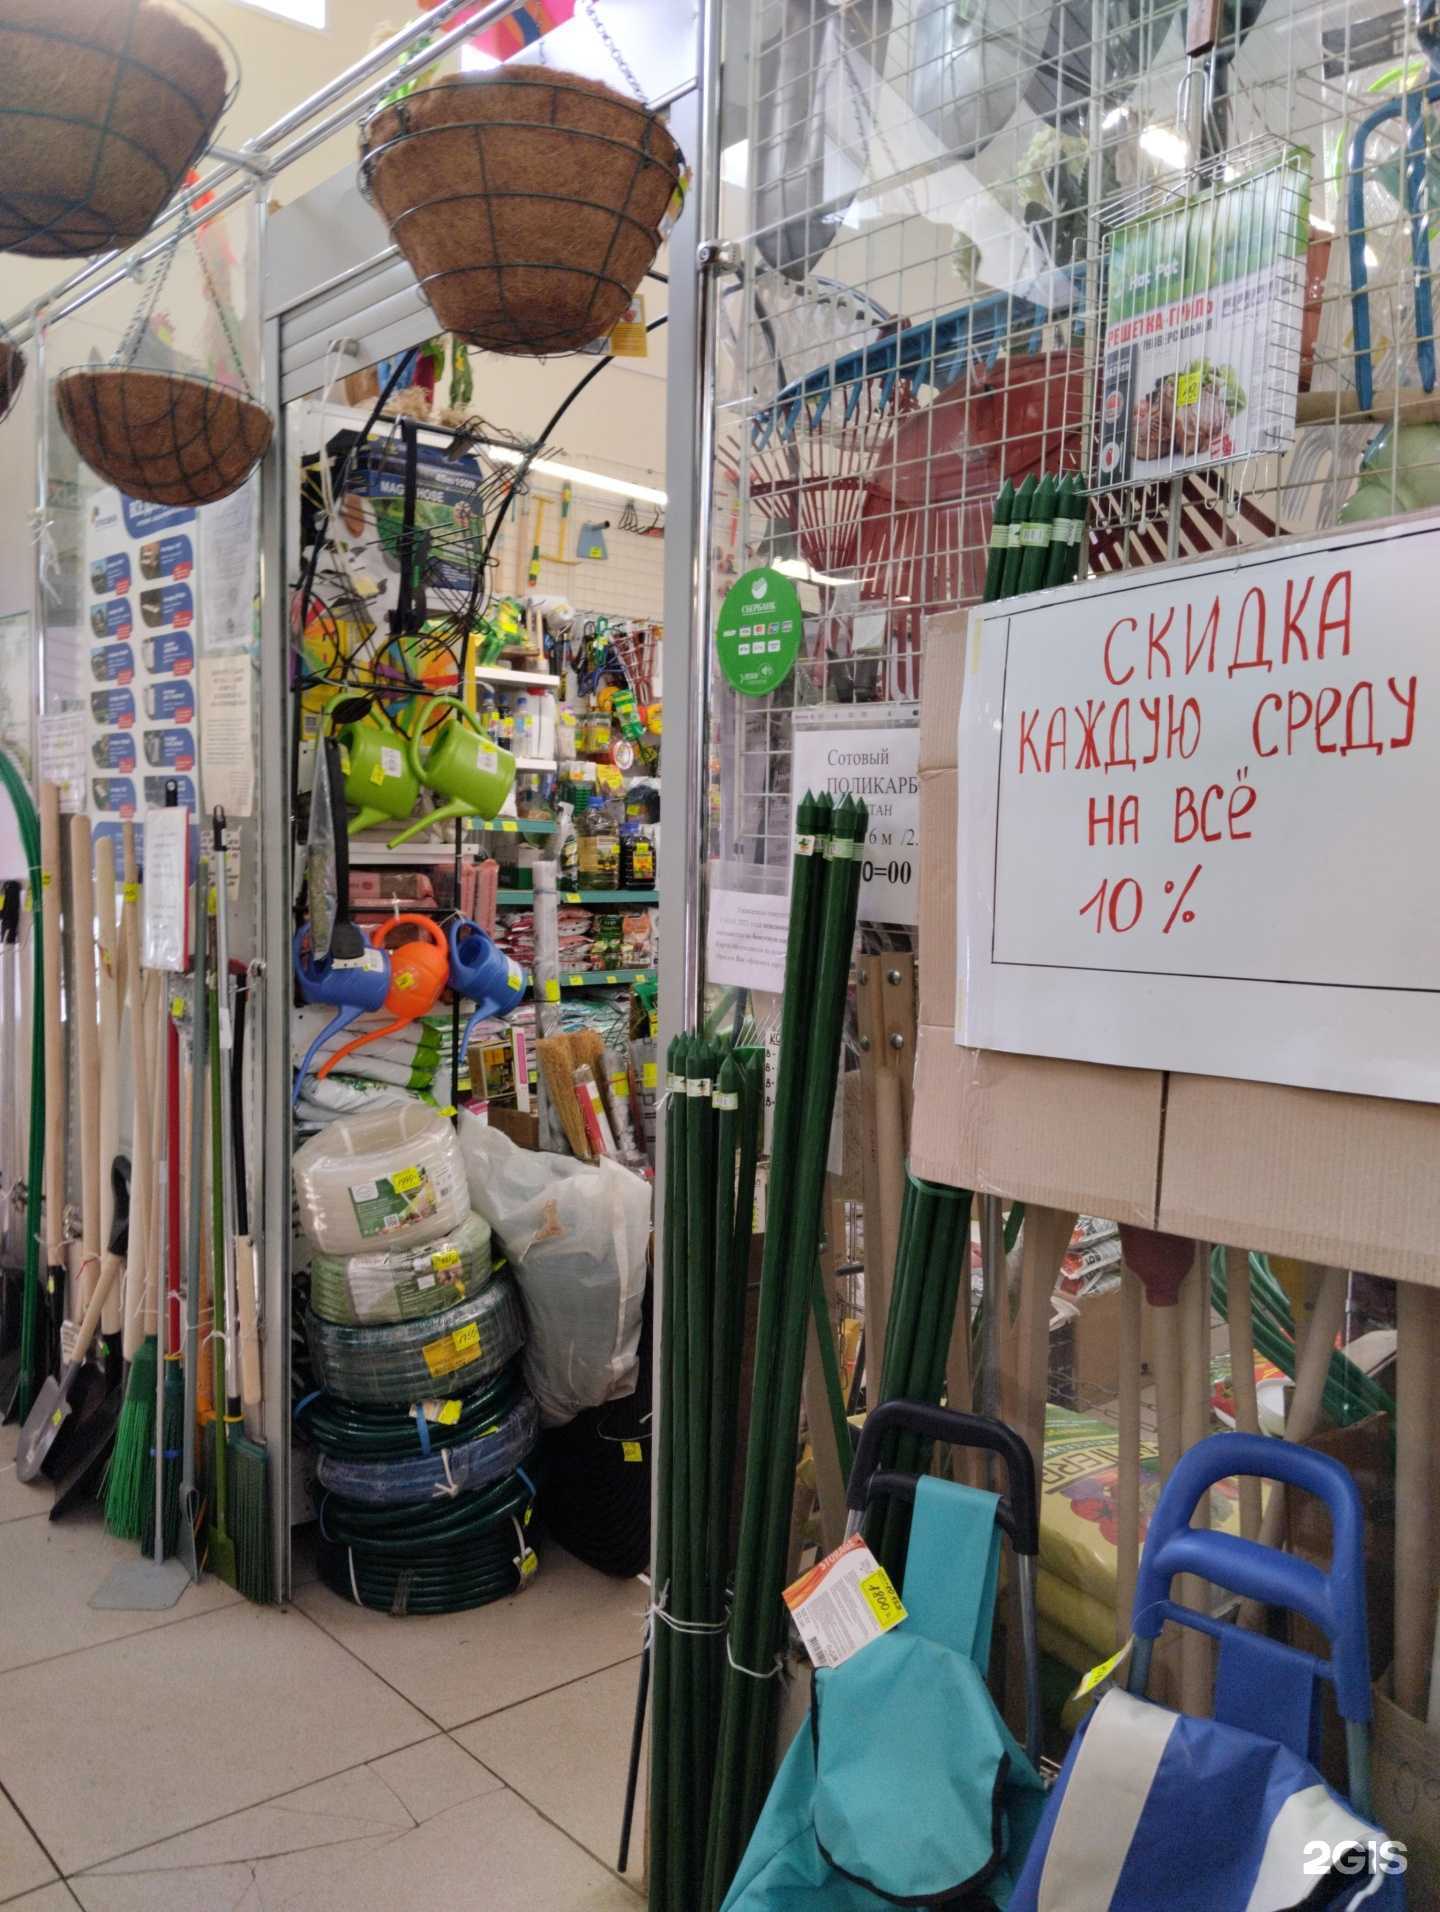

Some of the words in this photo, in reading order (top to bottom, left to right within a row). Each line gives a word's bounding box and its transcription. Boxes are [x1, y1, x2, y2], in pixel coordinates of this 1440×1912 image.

[1104, 570, 1352, 685] СКИДКА
[1018, 695, 1201, 774] КАЖДУЮ
[828, 748, 889, 766] Сотовый
[827, 777, 918, 794] ПОЛИКАРБ
[869, 803, 893, 816] ТАН
[1088, 794, 1139, 846] НА
[862, 860, 912, 885] 0=00
